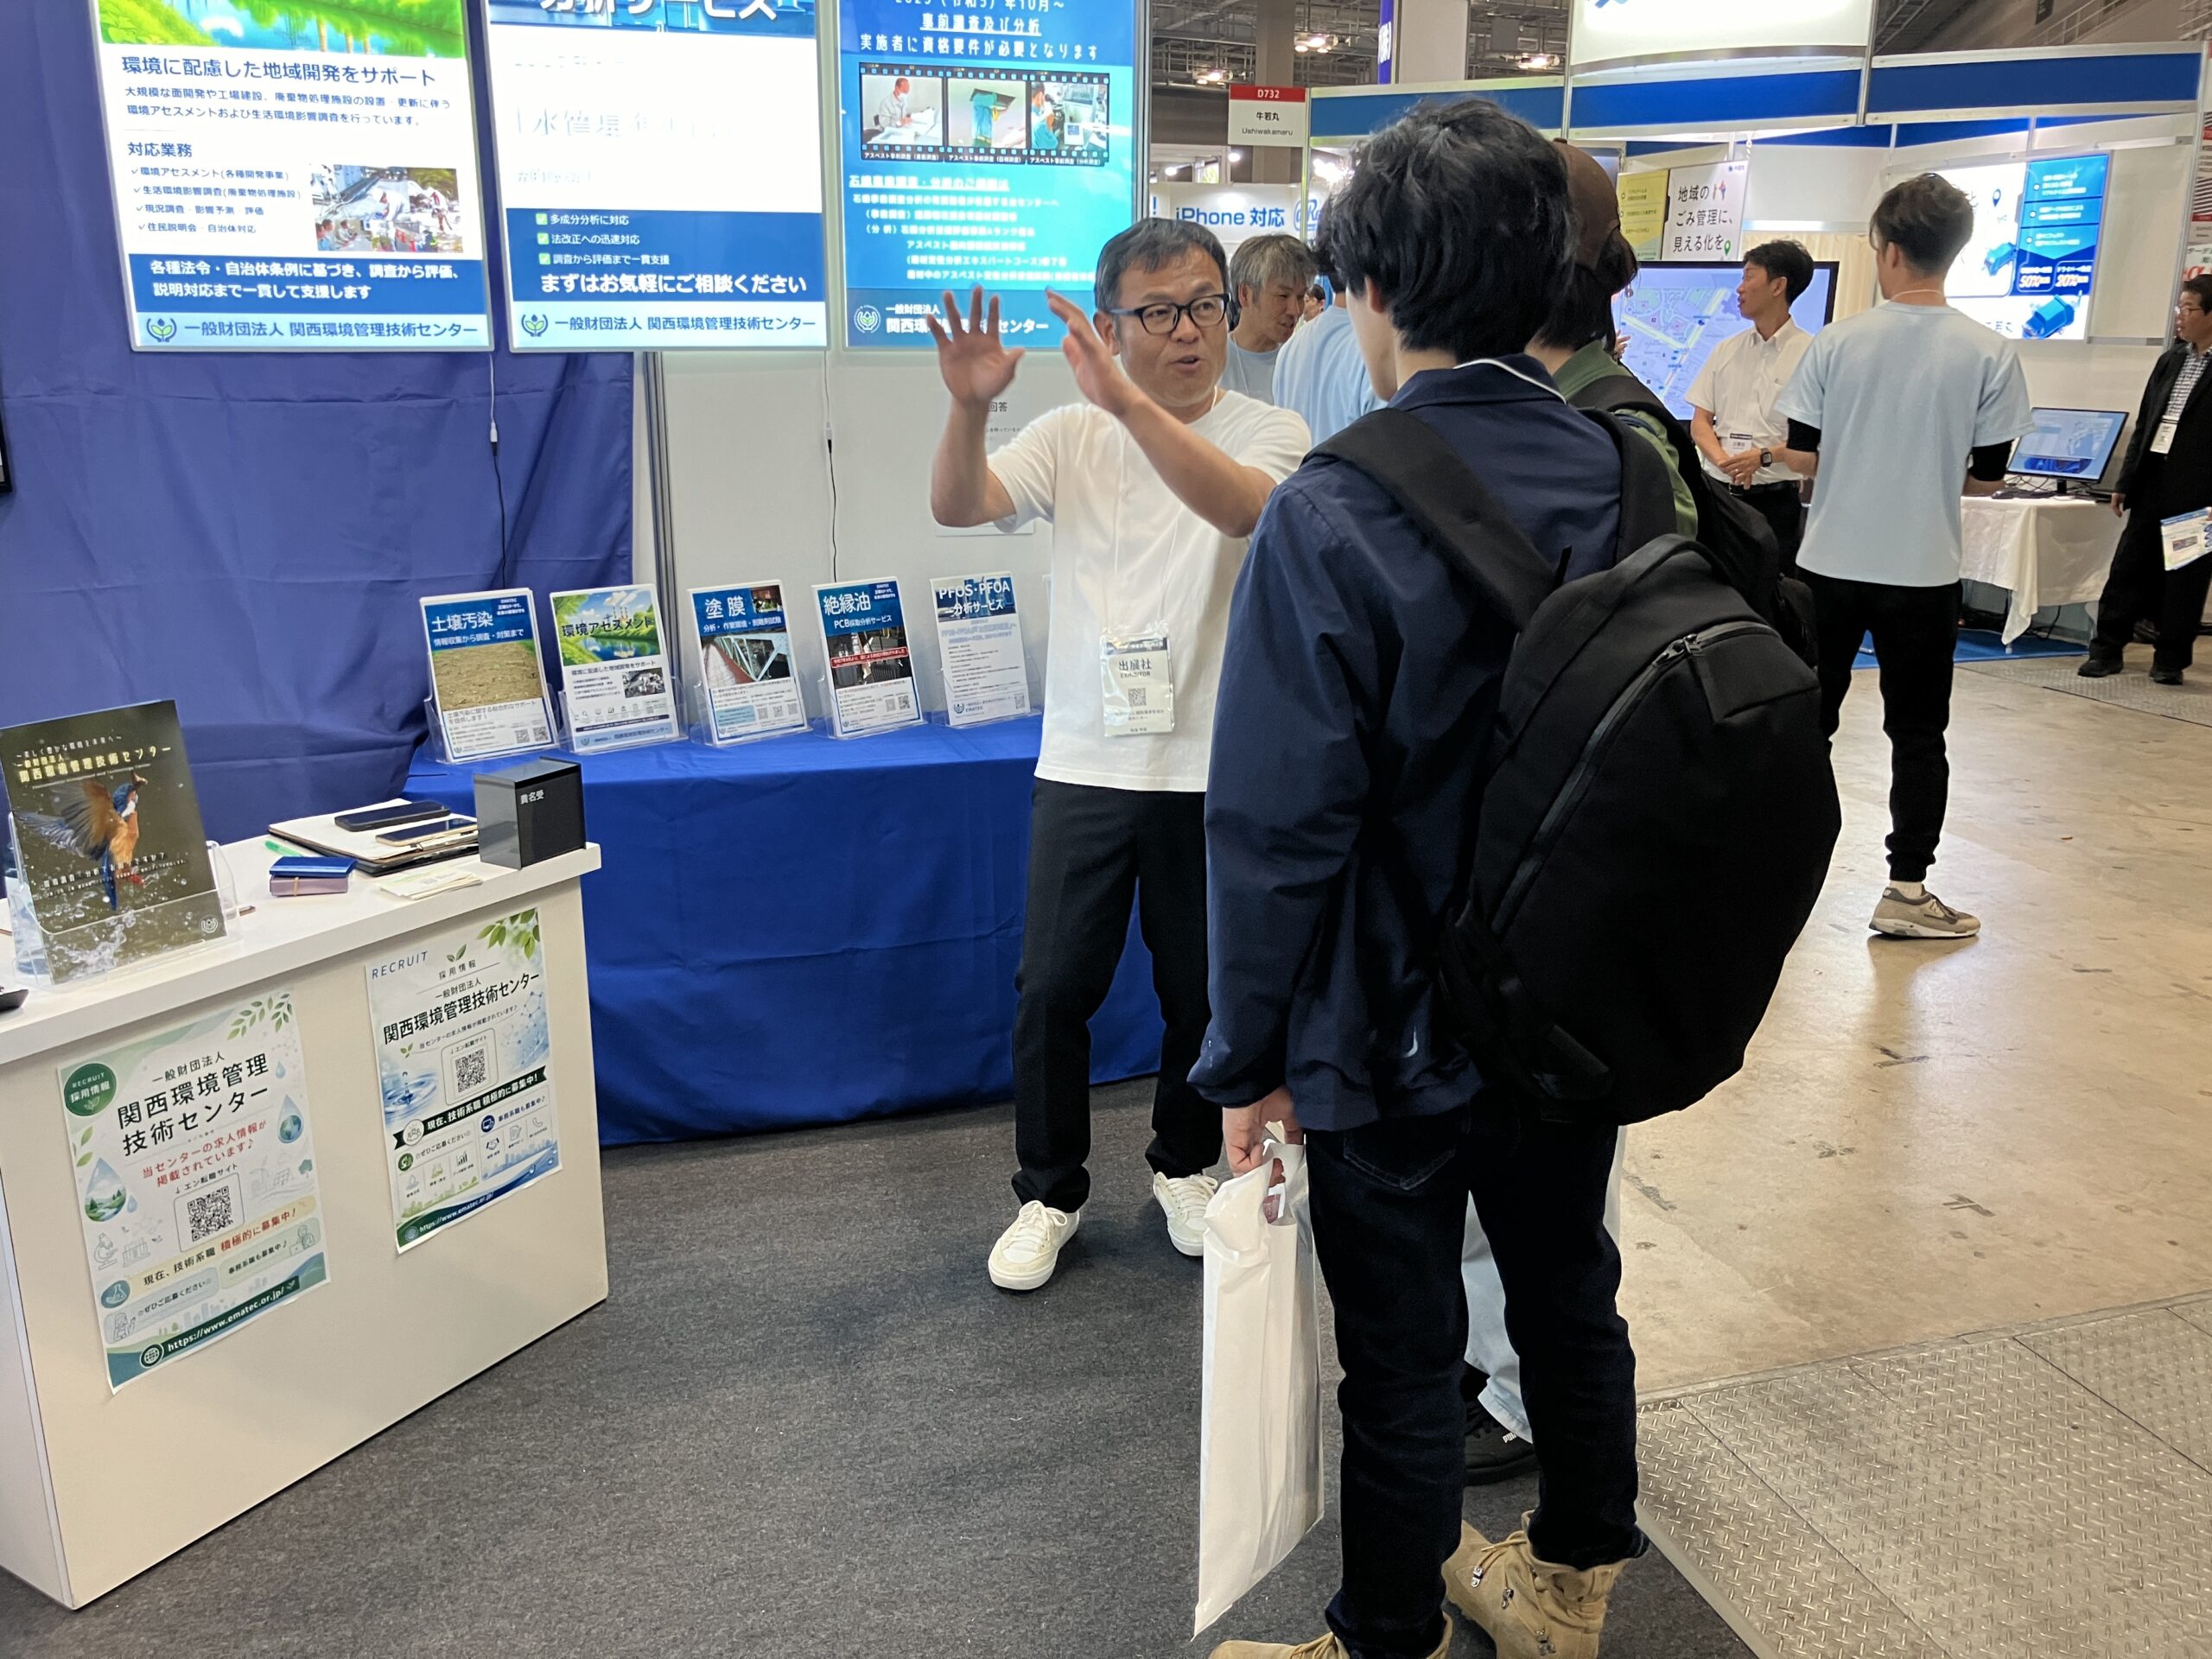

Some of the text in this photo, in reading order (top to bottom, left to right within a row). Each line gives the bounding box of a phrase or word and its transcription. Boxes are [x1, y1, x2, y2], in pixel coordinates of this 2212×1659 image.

[860, 34, 1097, 60] 実施者に資格要件が必要となります
[122, 56, 435, 86] 環境に配慮した地域開発をサポート
[1257, 89, 1280, 99] D732
[1256, 111, 1279, 121] 牛若丸
[1242, 127, 1293, 137] Ushiwakamaru
[128, 142, 193, 157] 対応業務
[1677, 186, 1709, 203] 地域の
[550, 214, 629, 226] 多成分分析に対応
[1175, 207, 1244, 226] iPhone
[1249, 207, 1286, 227] 対応
[1676, 209, 1733, 226] ごみ管理に、
[551, 233, 640, 245] 法改正への迅速対応
[1673, 234, 1725, 253] 見える化を
[553, 253, 670, 265] 調査から評価まで一貫支援
[150, 260, 459, 279] 各種法令・自治体条例に基づき、調査から評価、
[153, 282, 372, 300] 説明対応まで一貫して支援します
[541, 274, 807, 295] まずはお気軽にご相談ください
[185, 321, 478, 338] 一般財団法人 関西環境管理技術センター
[555, 316, 816, 332] 一般財団法人 関西環境管理技術センター
[823, 592, 872, 616] 絶縁油
[953, 599, 1003, 616] 分析サービス
[1119, 658, 1152, 671] 出展社
[372, 951, 429, 980] RECRUIT
[435, 977, 481, 1000] 一般財団法人
[383, 972, 540, 1045] 関西環境管理技術センター
[152, 1052, 226, 1083] 一般財団法人
[72, 1072, 105, 1089] RECRUIT
[70, 1080, 111, 1103] 採用情報
[117, 1052, 269, 1129] 関西環境管理
[123, 1087, 269, 1157] 技術センター
[143, 1120, 267, 1179] 当センターの求人情報が
[167, 1286, 285, 1352] https://www.ematec.or.jp/
